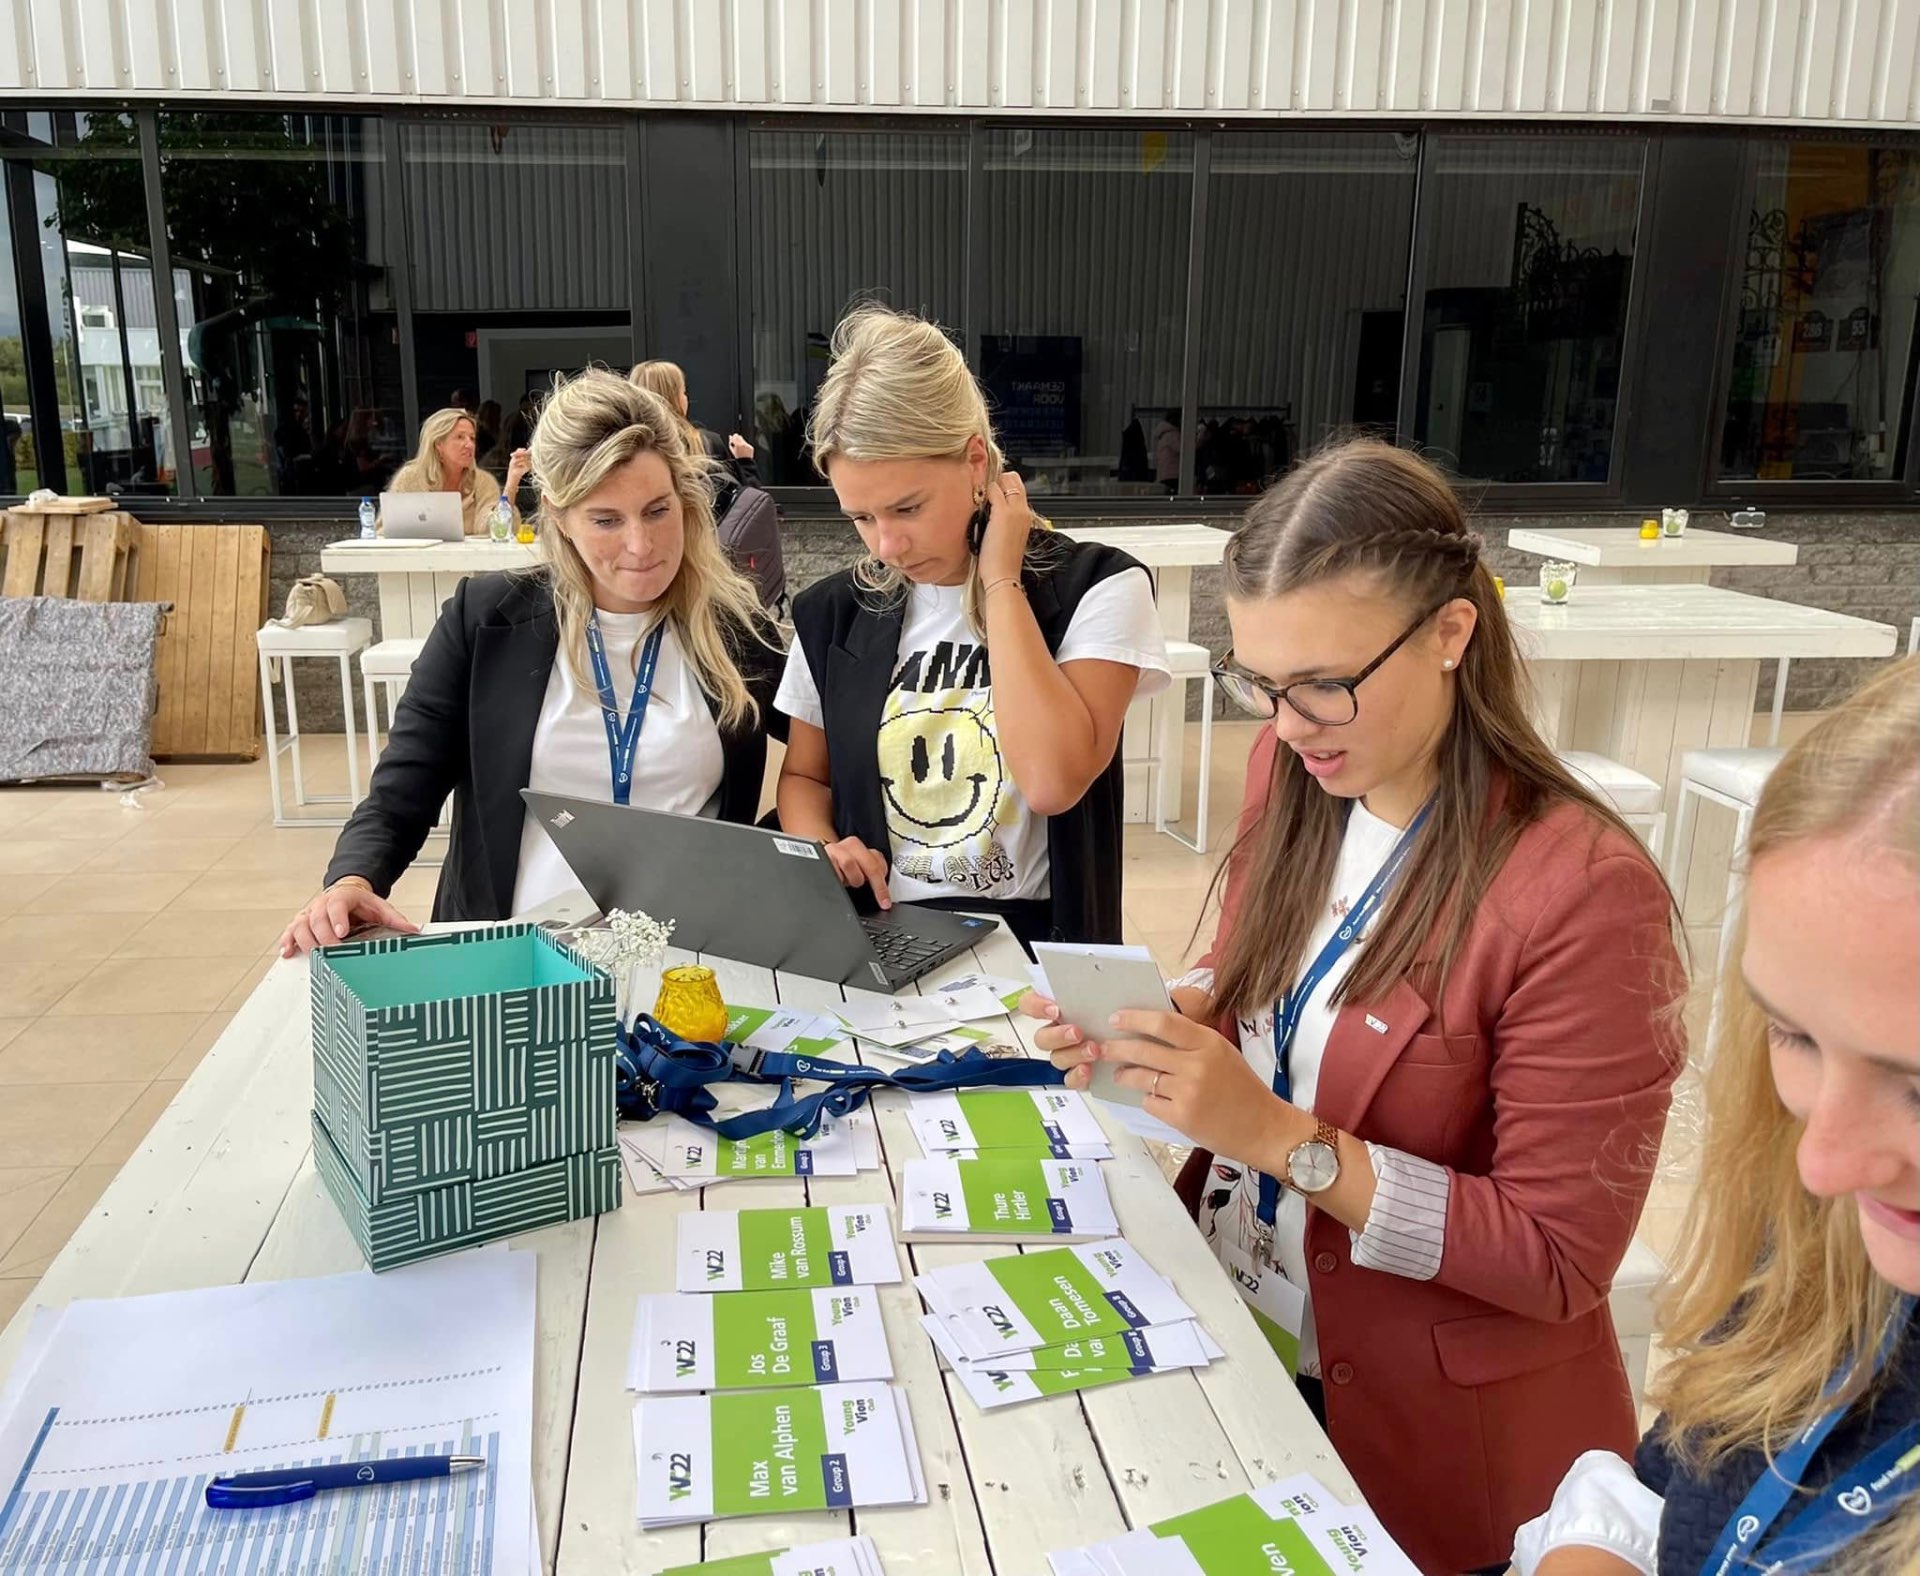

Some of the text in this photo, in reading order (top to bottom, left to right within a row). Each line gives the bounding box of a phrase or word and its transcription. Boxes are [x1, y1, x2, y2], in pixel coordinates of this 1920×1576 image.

[755, 1153, 767, 1170] van
[1068, 1167, 1079, 1182] Vion
[994, 1193, 1010, 1221] Thure
[1011, 1190, 1031, 1220] Hirtler
[846, 1215, 855, 1240] Young
[855, 1214, 866, 1232] Vion
[790, 1216, 810, 1279] van Rossum
[1104, 1250, 1123, 1270] Vion
[771, 1251, 788, 1280] Mike
[836, 1260, 847, 1277] Group
[1093, 1252, 1118, 1278] Young
[831, 1297, 843, 1326] Young
[843, 1297, 854, 1317] Vion
[1048, 1298, 1081, 1329] Daan
[1054, 1275, 1102, 1326] Tomesen
[1118, 1300, 1137, 1319] Group
[766, 1317, 790, 1374] De Graaf
[1132, 1337, 1146, 1357] Group
[748, 1354, 766, 1375] Jos
[821, 1349, 833, 1371] Group
[843, 1400, 855, 1436] Young
[855, 1399, 867, 1424] Vion
[772, 1405, 799, 1496] van Alphen
[750, 1459, 770, 1497] Max
[832, 1466, 844, 1493] Group
[1292, 1495, 1315, 1515] ion
[1326, 1528, 1363, 1573] Young
[1340, 1525, 1368, 1558] Vion
